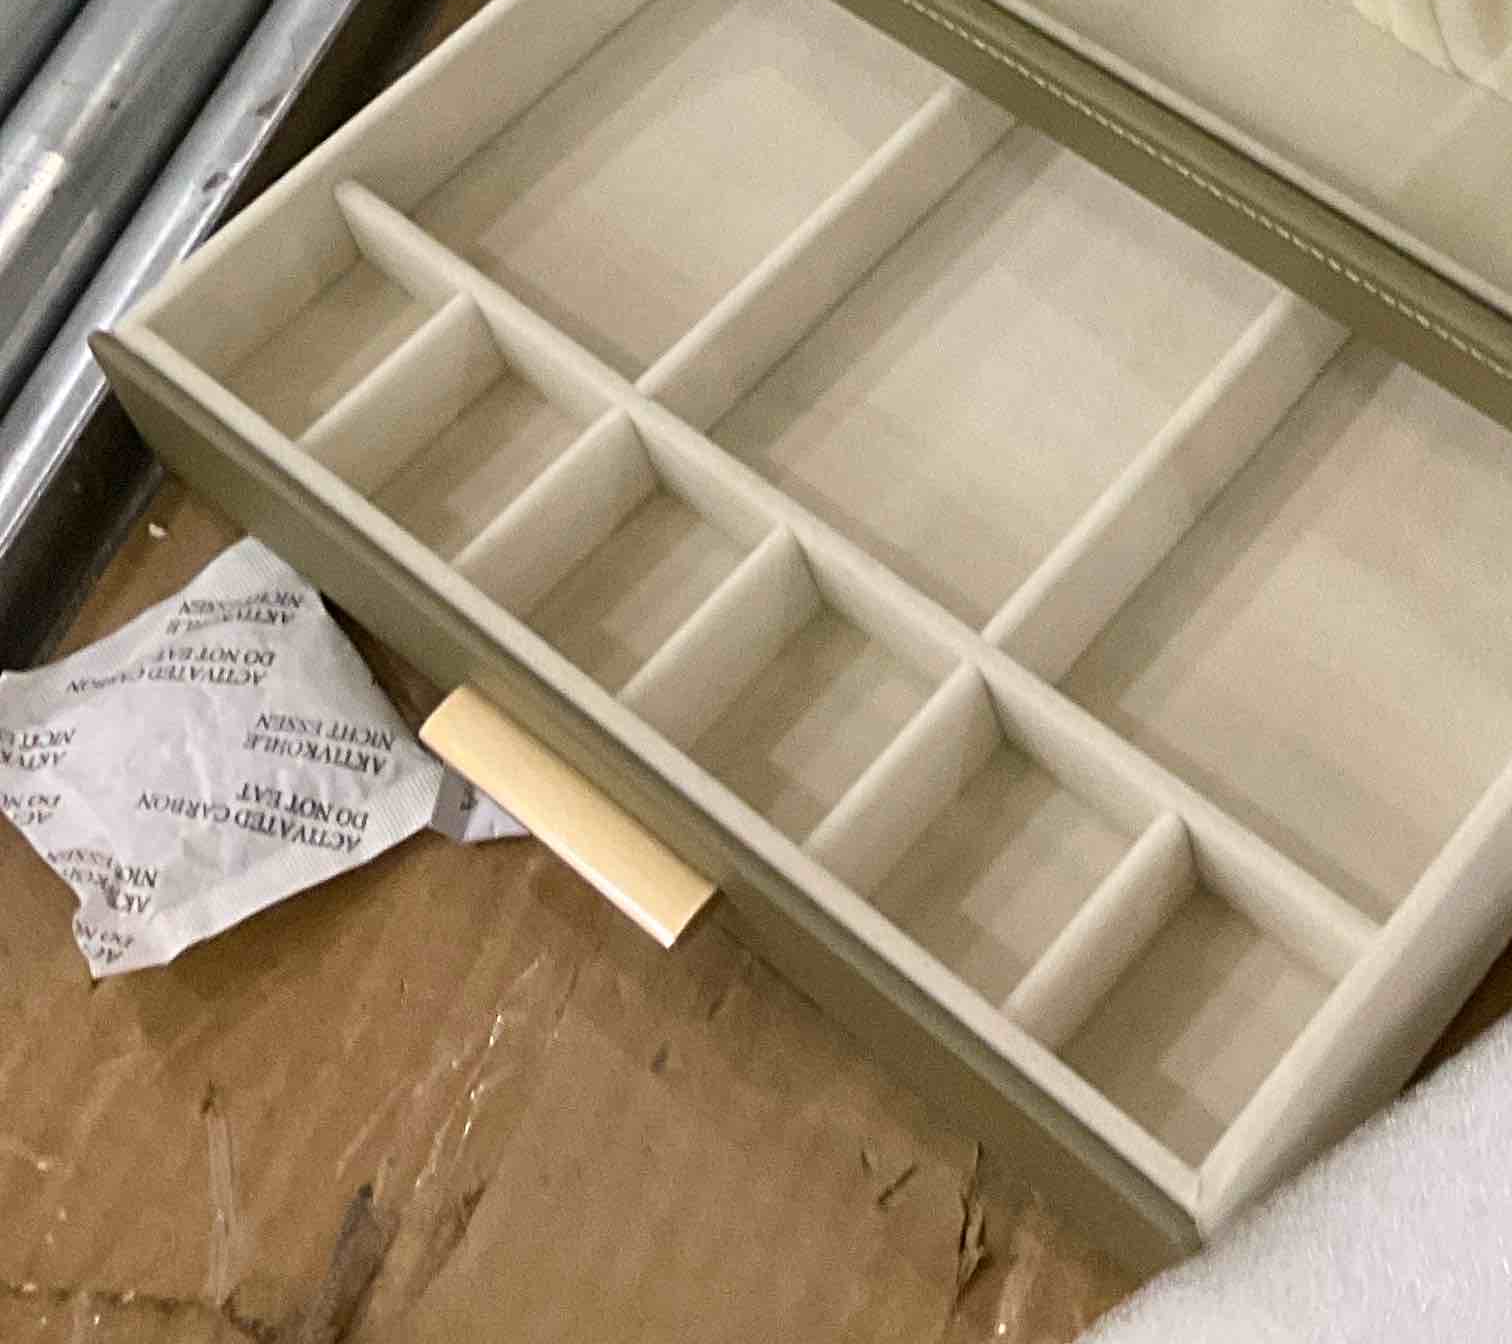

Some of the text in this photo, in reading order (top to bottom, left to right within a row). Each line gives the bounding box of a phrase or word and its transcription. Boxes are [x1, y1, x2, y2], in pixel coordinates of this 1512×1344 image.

[194, 648, 240, 664] NOT
[243, 651, 276, 667] DO
[148, 666, 268, 687] ACTIVATED
[256, 714, 396, 752] NICHT ESSEN
[242, 734, 387, 776] AKTIVKOHLE
[138, 793, 361, 853] ACTIVATED CARBON
[236, 783, 369, 832] DO NOT EAT
